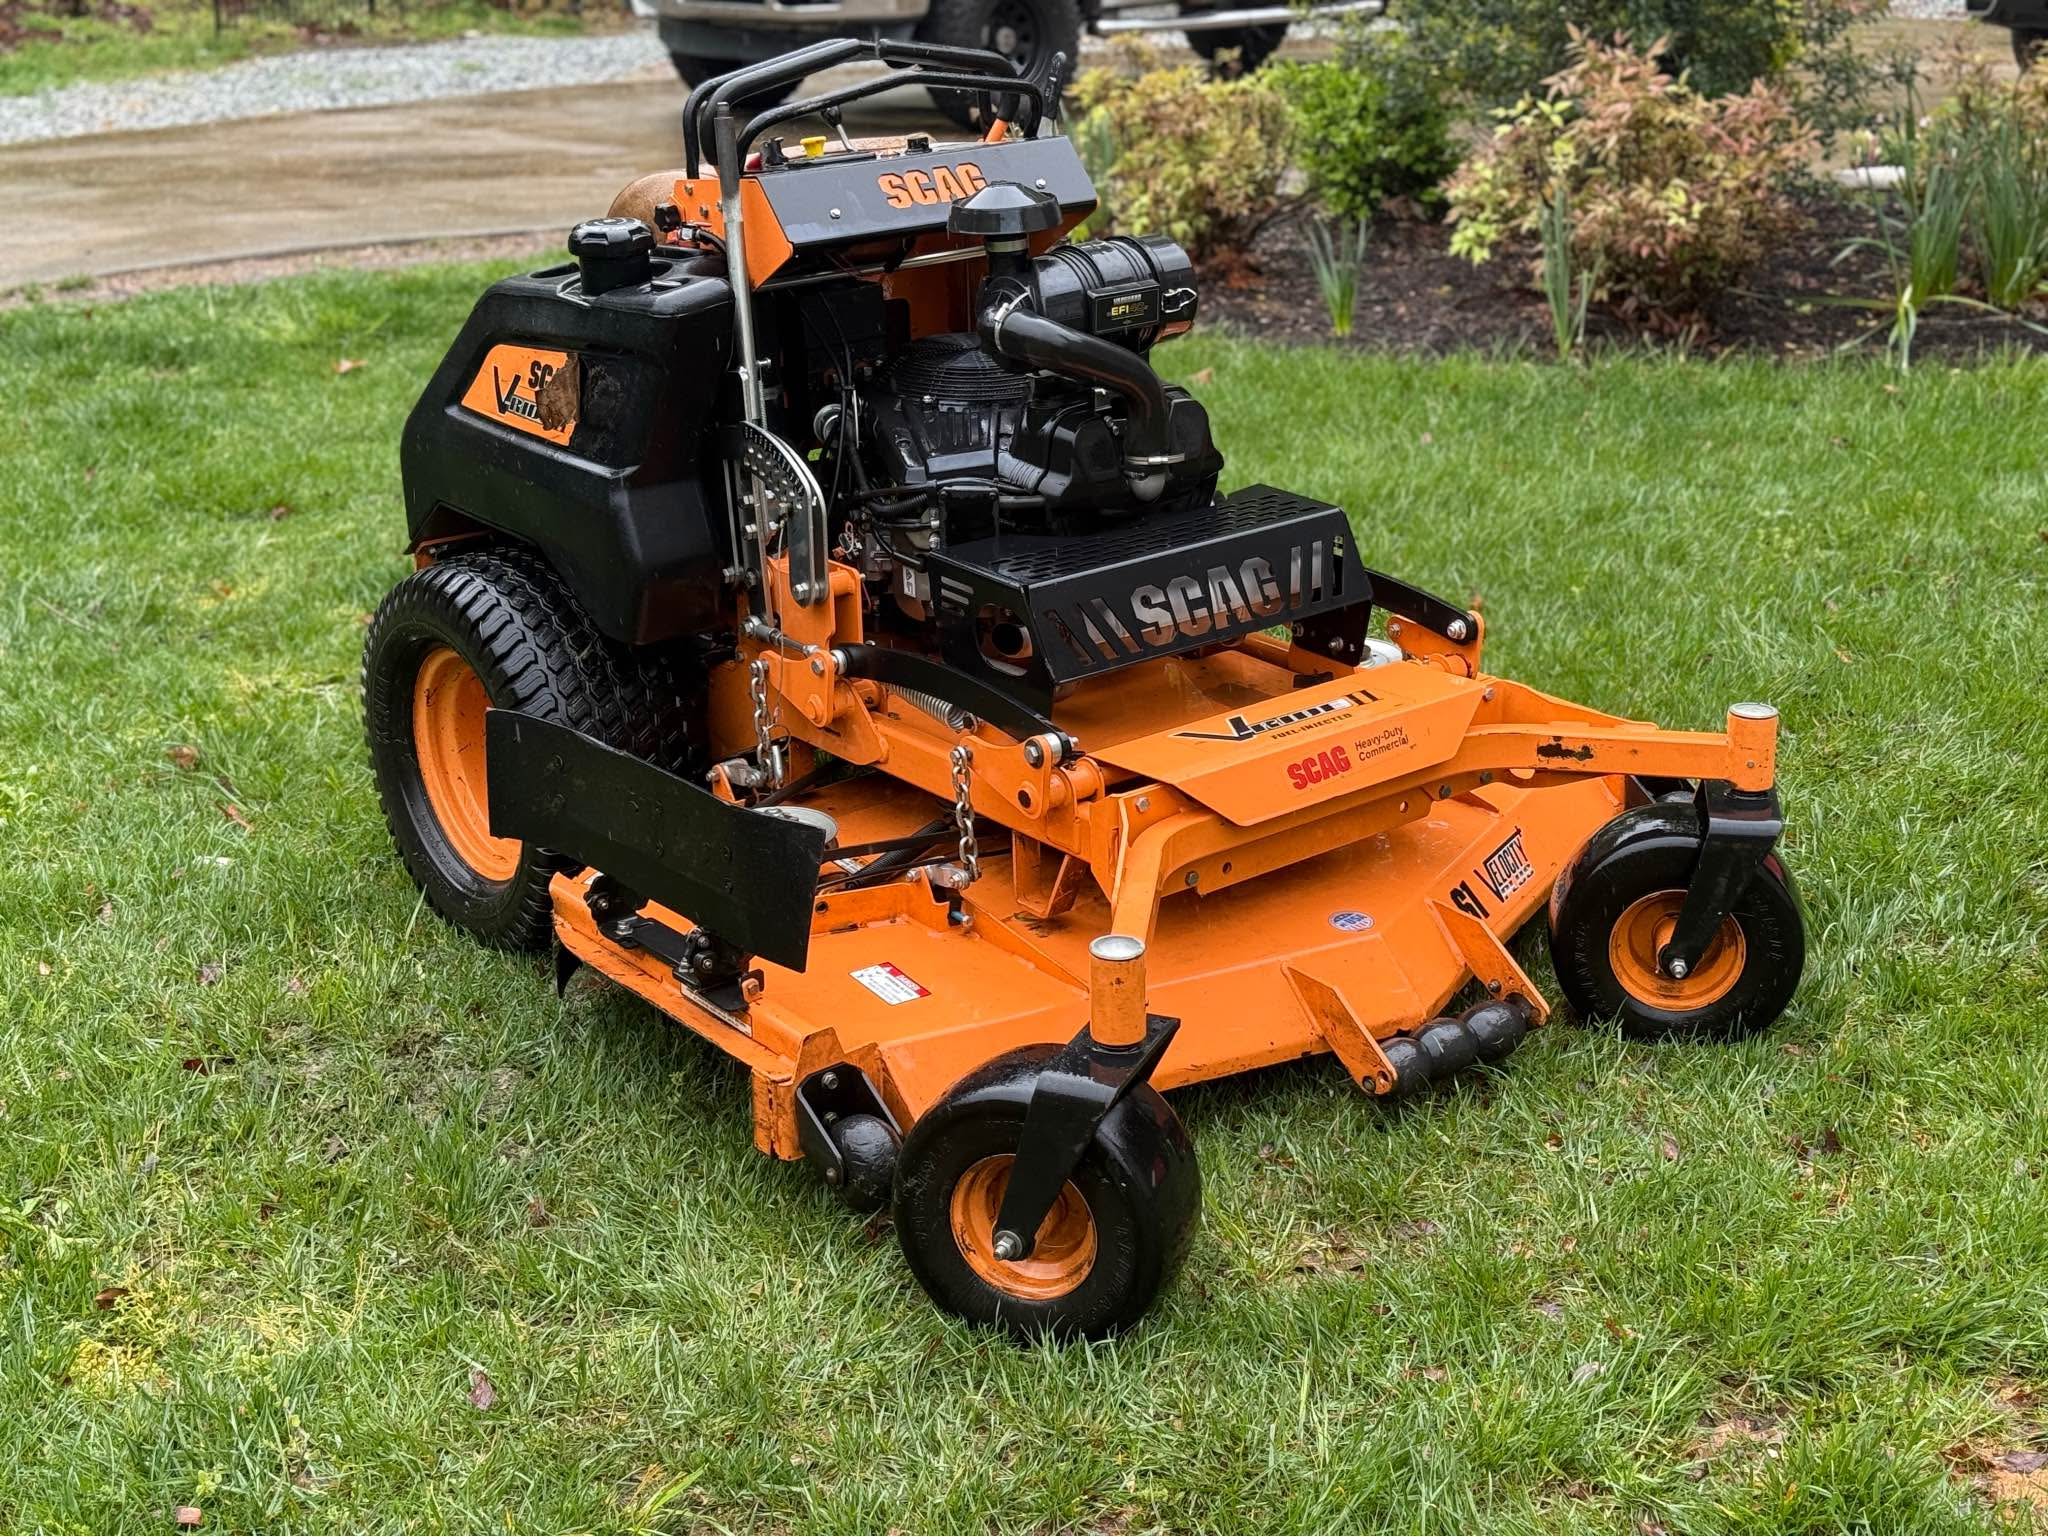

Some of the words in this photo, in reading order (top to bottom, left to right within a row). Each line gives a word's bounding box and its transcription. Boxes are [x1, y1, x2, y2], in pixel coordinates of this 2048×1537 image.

[878, 162, 988, 209] SCAG
[1130, 557, 1285, 646] SCAG
[1271, 713, 1353, 740] FUEL-INJECTED
[1354, 727, 1404, 751] Heavy-Duty
[1358, 734, 1409, 762] Commercial
[1286, 745, 1351, 790] SCAG
[1473, 831, 1528, 903] VELOCITY
